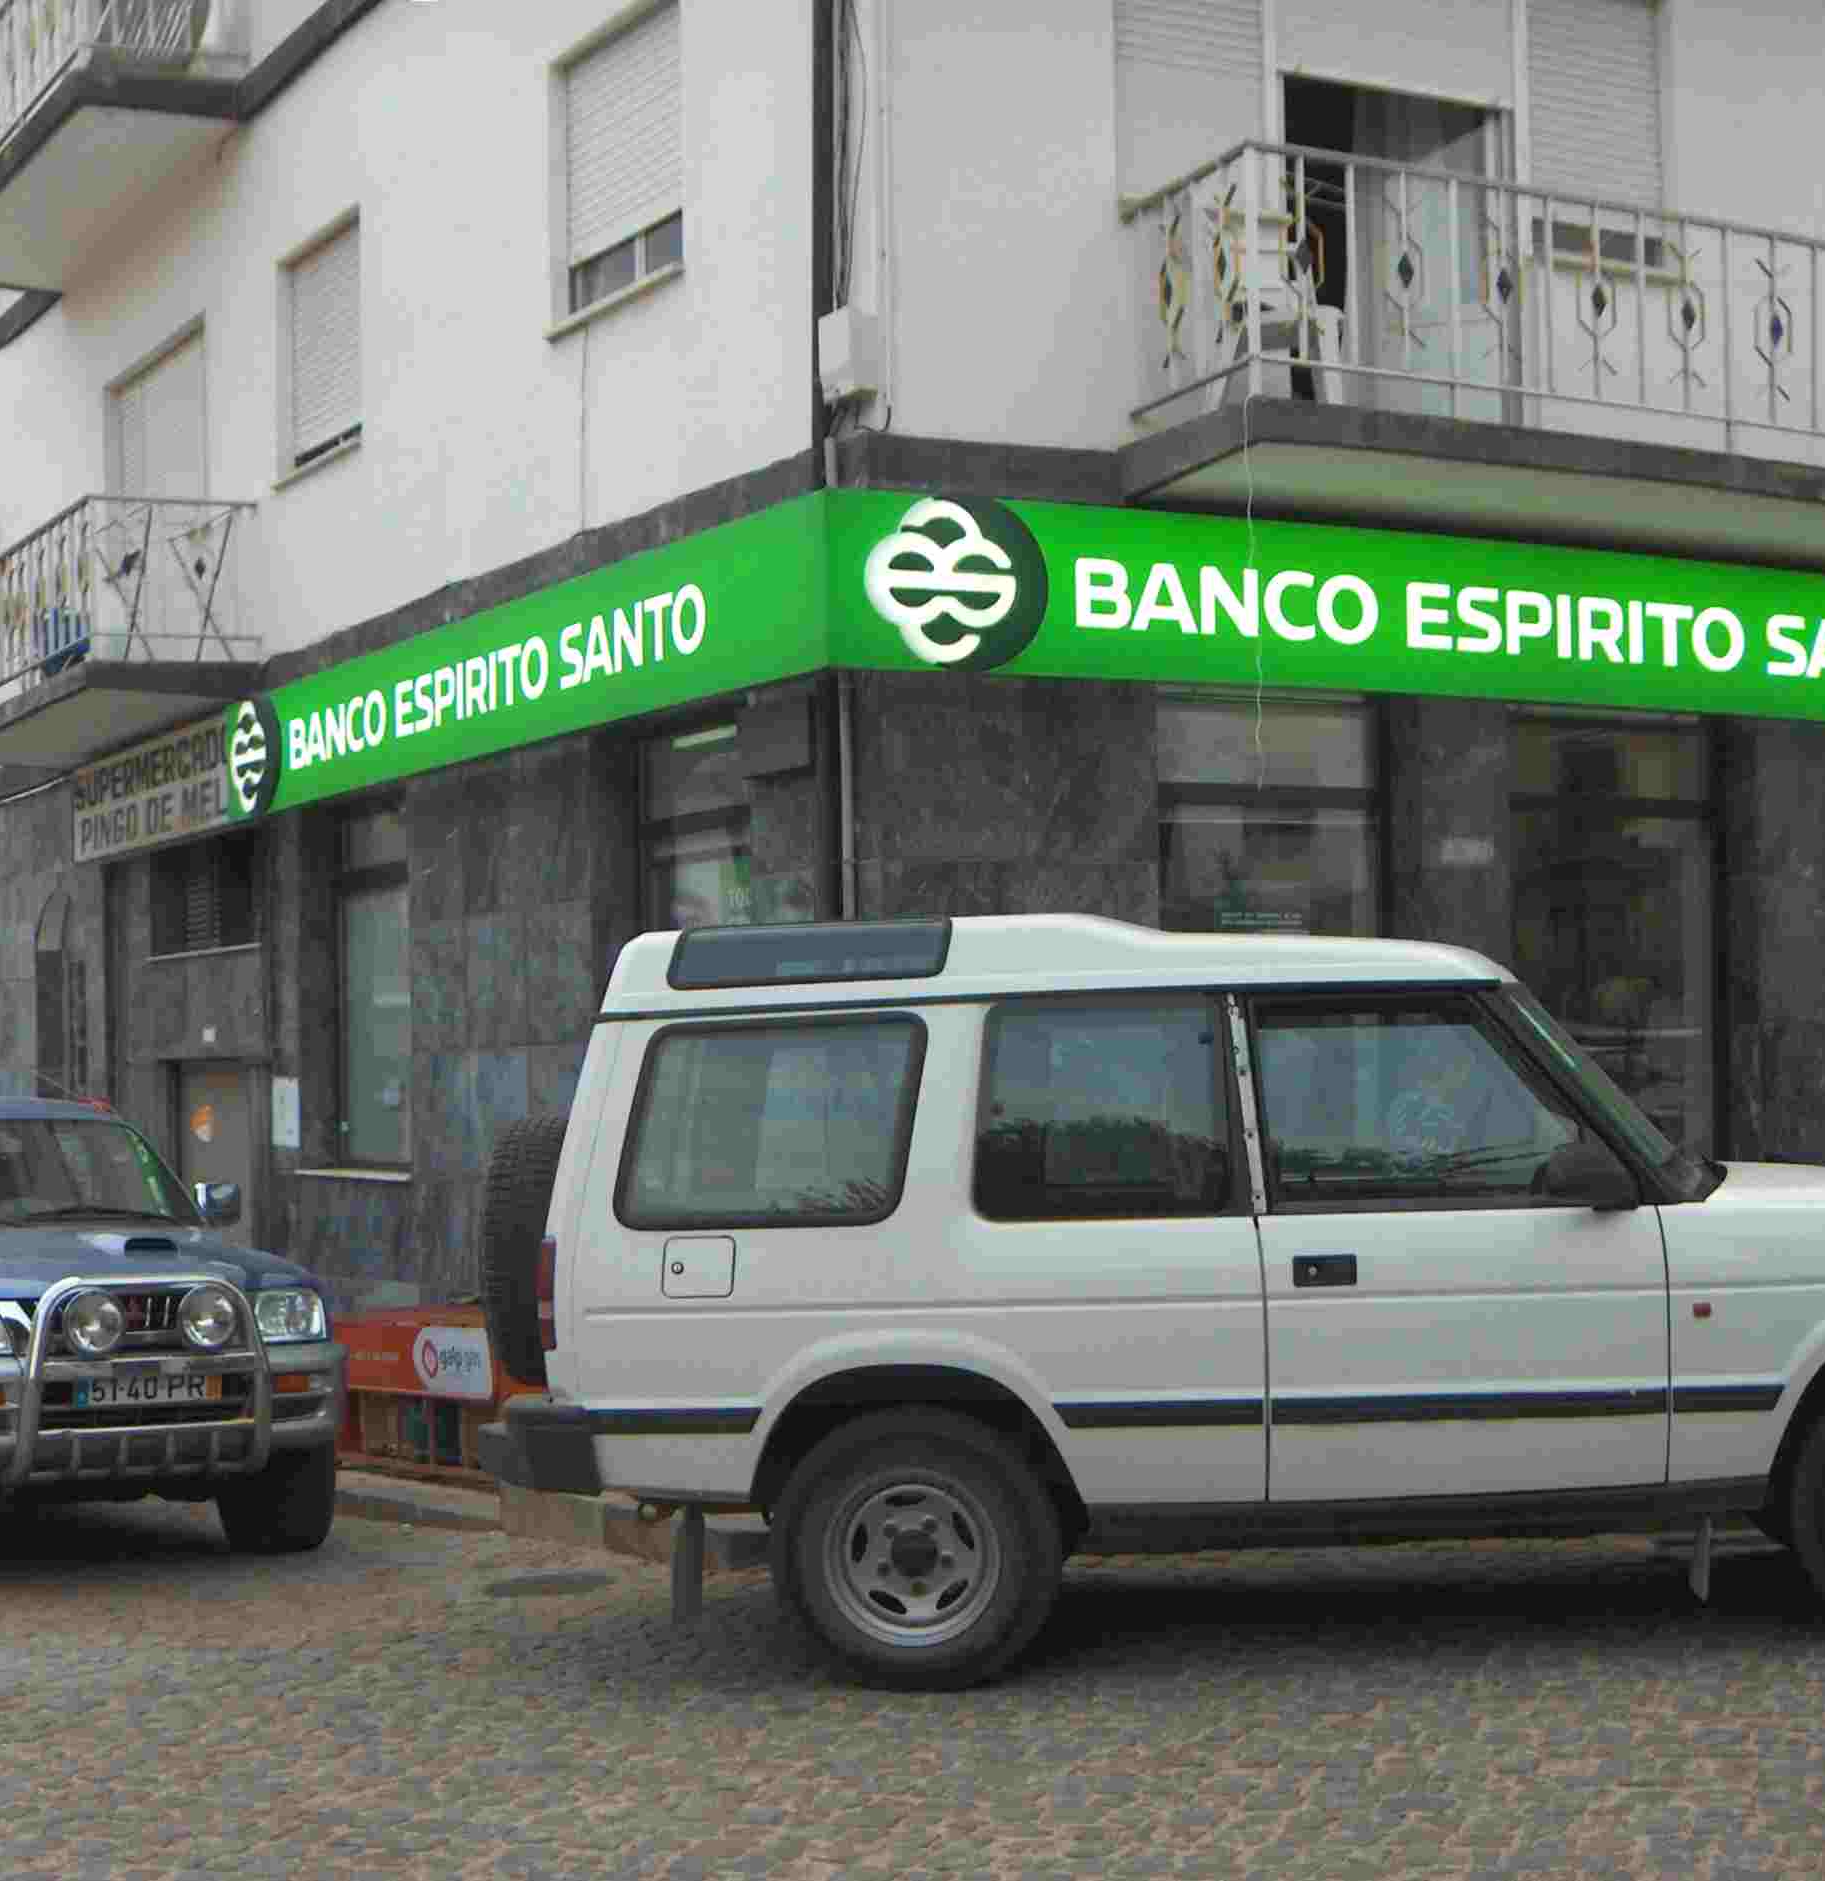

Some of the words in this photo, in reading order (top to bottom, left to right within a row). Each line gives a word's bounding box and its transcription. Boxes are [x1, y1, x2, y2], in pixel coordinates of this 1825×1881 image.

[1074, 557, 1379, 645] BANCO
[1406, 581, 1745, 672] ESPIRITO
[289, 689, 385, 770] BANCO
[394, 635, 549, 738] ESPIRITO
[558, 584, 706, 690] SANTO
[81, 803, 138, 857] PINGO
[147, 794, 173, 835] DE
[182, 775, 225, 829] MEL
